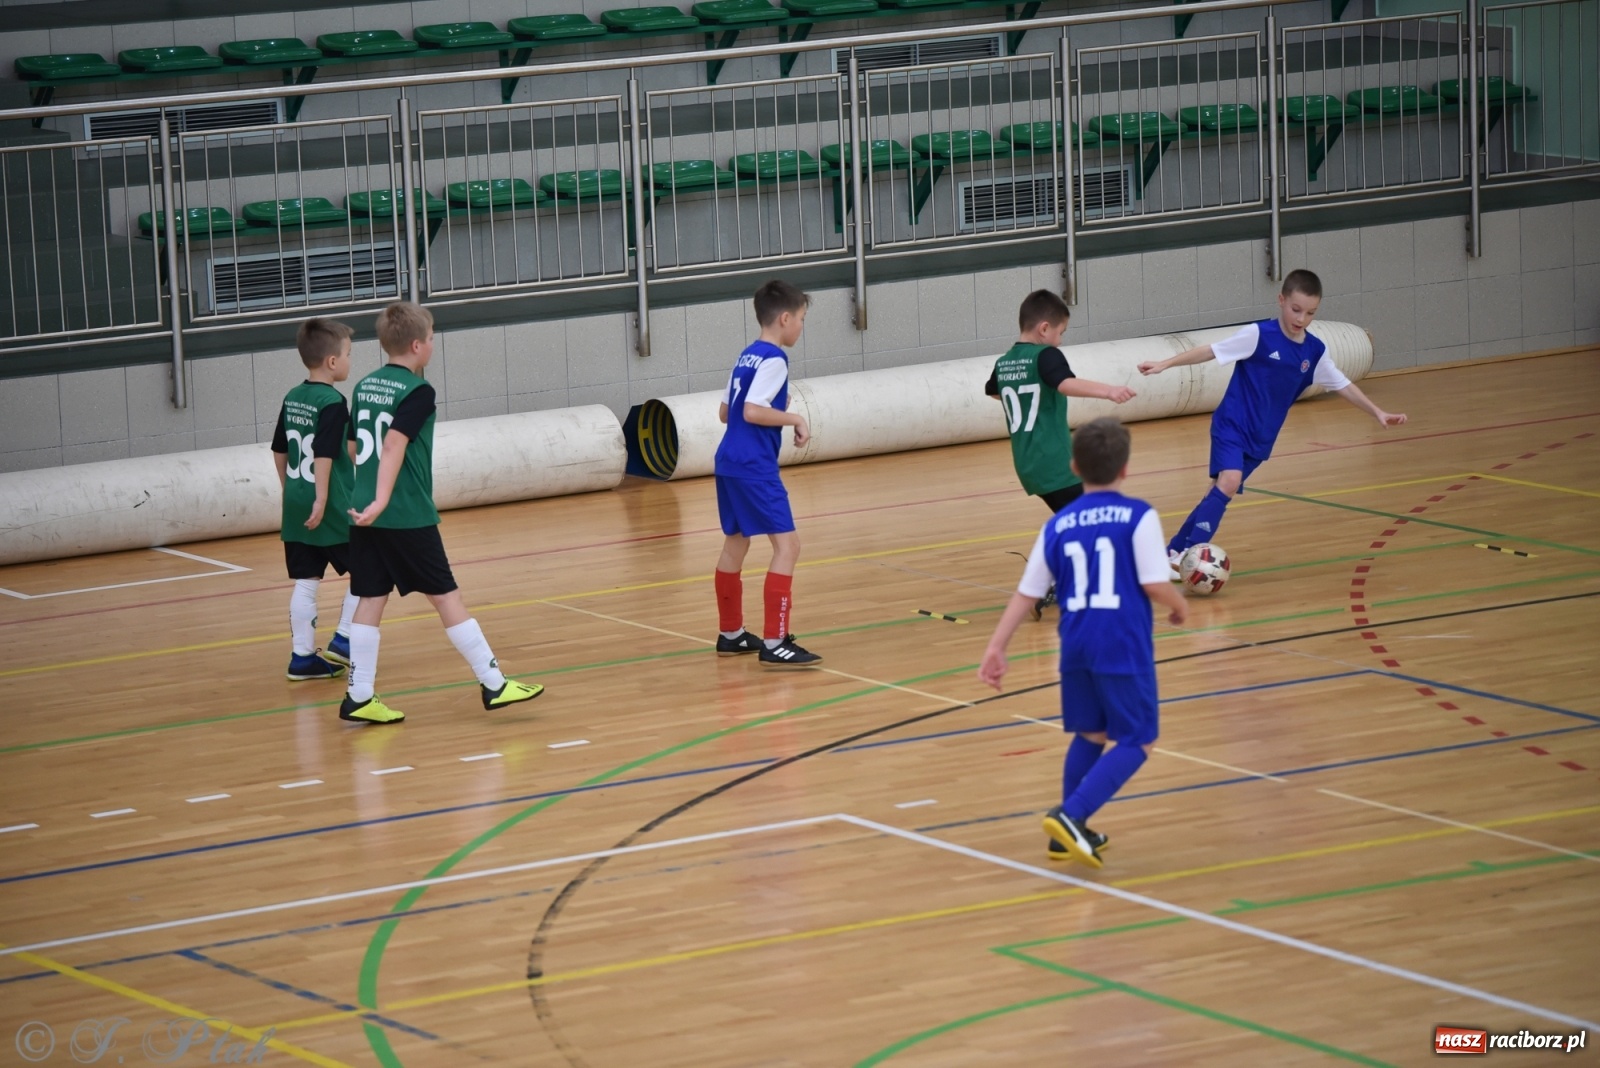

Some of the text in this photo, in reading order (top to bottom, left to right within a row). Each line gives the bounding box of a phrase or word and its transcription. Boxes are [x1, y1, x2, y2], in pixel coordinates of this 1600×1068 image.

[1001, 383, 1041, 434] 07
[285, 429, 316, 483] 08
[1079, 505, 1133, 527] CIESZYN
[1063, 536, 1121, 612] 11
